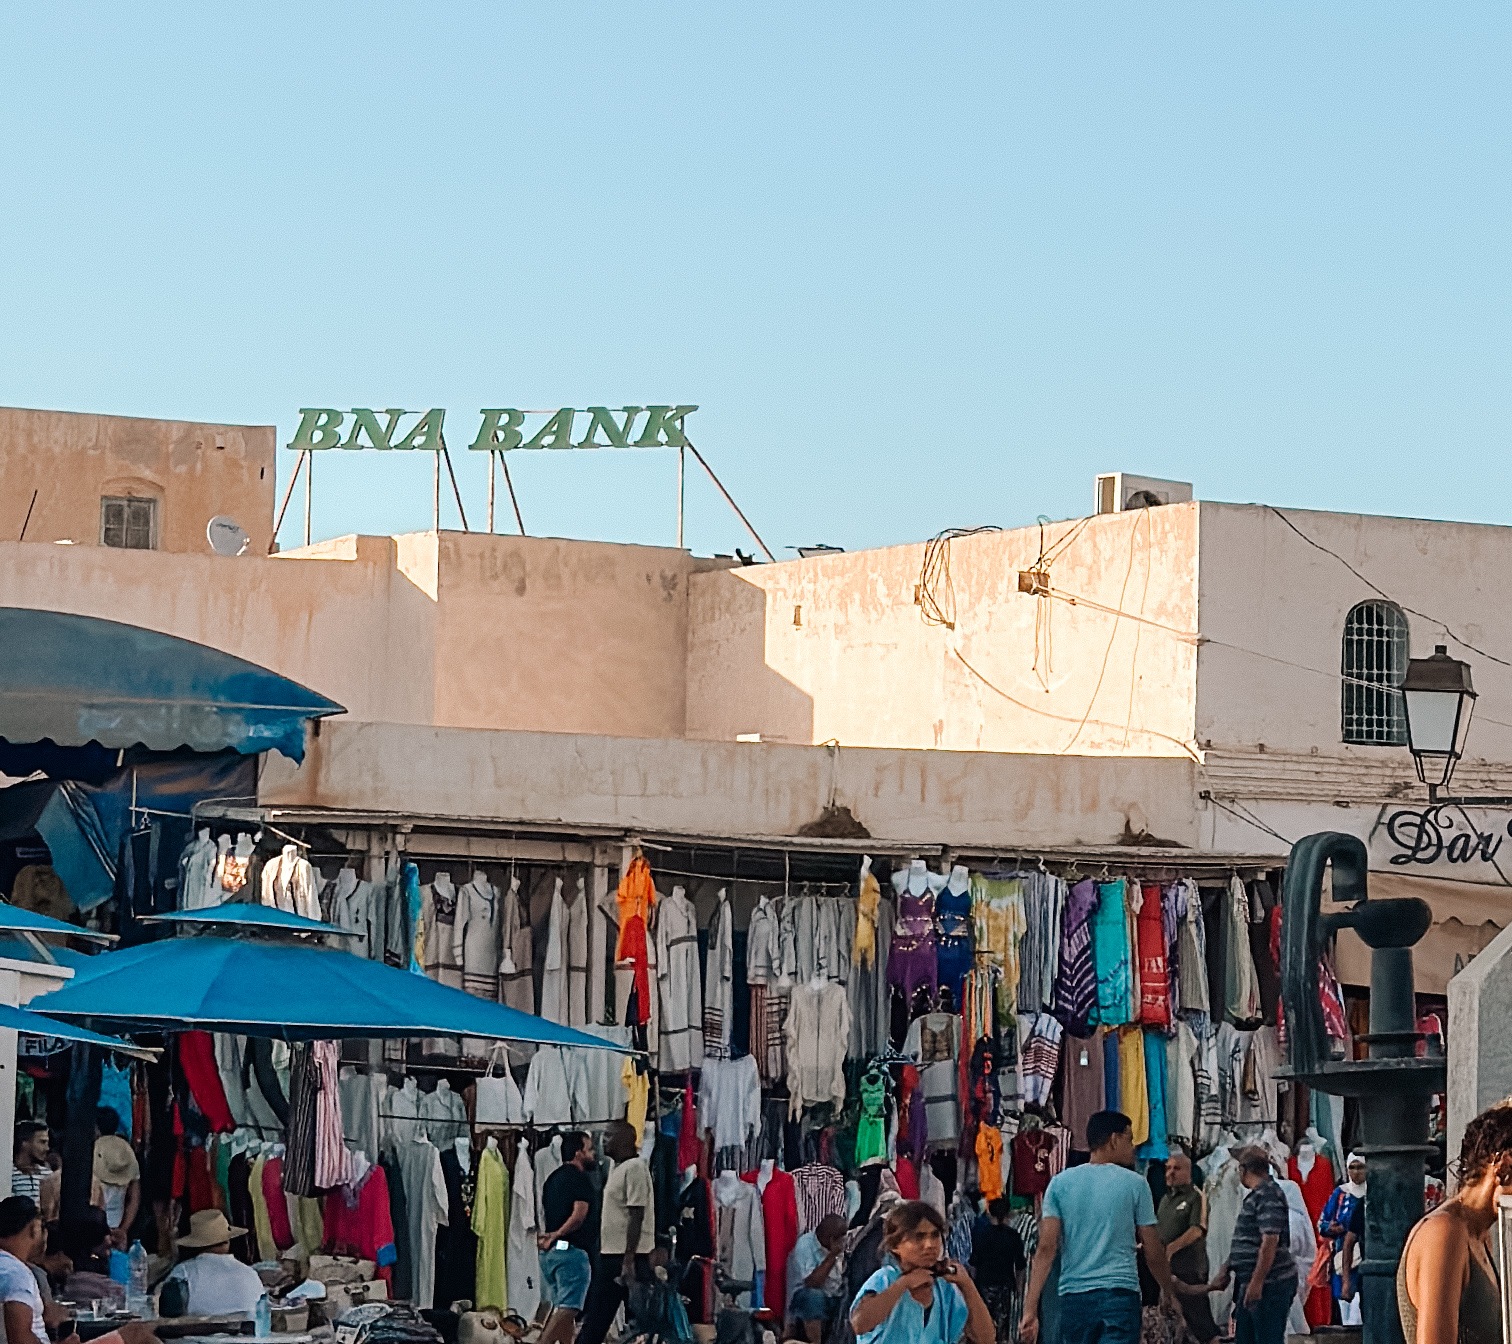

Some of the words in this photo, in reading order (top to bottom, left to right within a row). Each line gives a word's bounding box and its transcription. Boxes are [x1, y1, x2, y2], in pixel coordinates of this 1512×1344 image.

[287, 408, 446, 451] BNA
[468, 405, 700, 451] BANK
[1387, 804, 1503, 866] Dar
